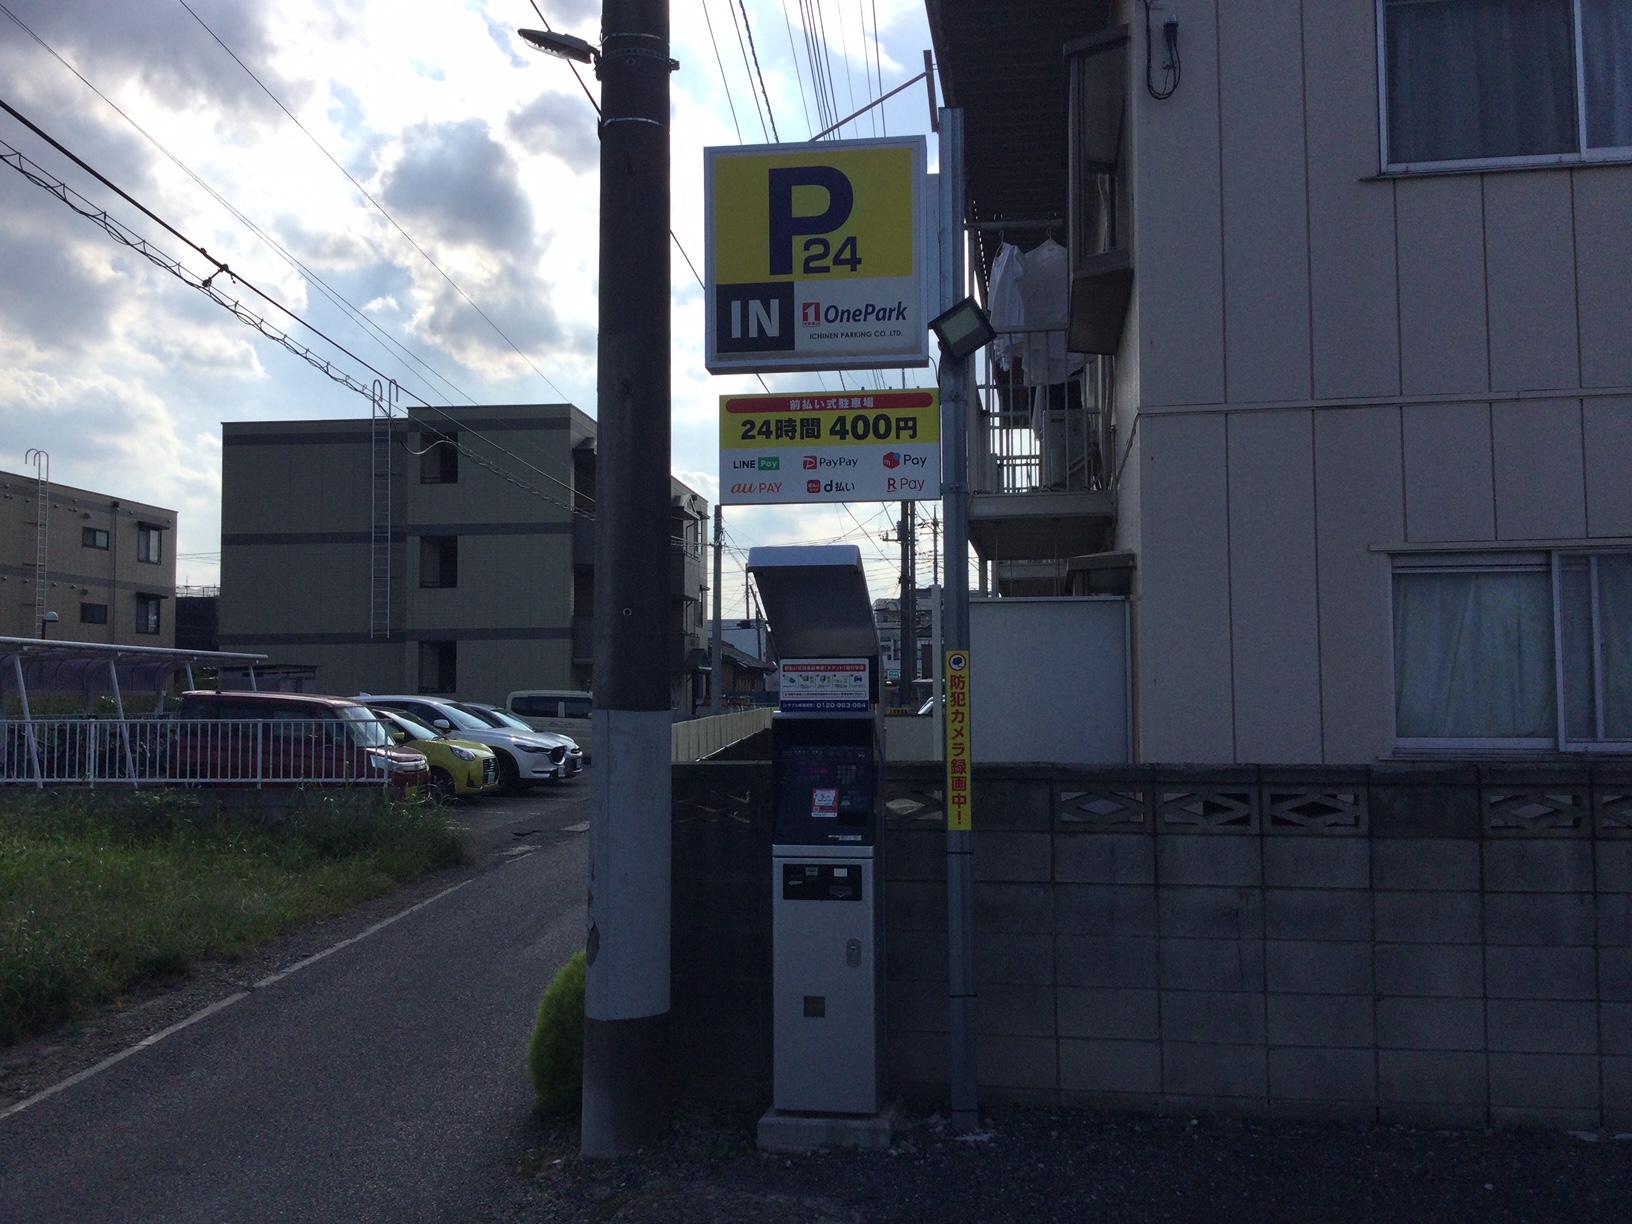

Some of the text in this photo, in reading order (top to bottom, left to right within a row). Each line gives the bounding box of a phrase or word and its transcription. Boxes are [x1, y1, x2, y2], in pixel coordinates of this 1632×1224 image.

[769, 166, 854, 275] P
[803, 236, 862, 274] 24
[731, 298, 779, 339] IN
[824, 301, 907, 323] OnePark
[809, 332, 838, 340] ICHINEN
[840, 331, 872, 339] PARKING
[789, 397, 874, 410] 前払い式駐車場
[740, 414, 917, 440] 24時間 400円
[733, 458, 778, 469] LINE Pay
[819, 456, 858, 468] PayPay
[903, 454, 927, 467] Pay
[731, 482, 783, 494] au PAY
[824, 479, 856, 493] d払い
[900, 477, 925, 492] Pay
[949, 674, 967, 824] 防犯カメラ録画中!
